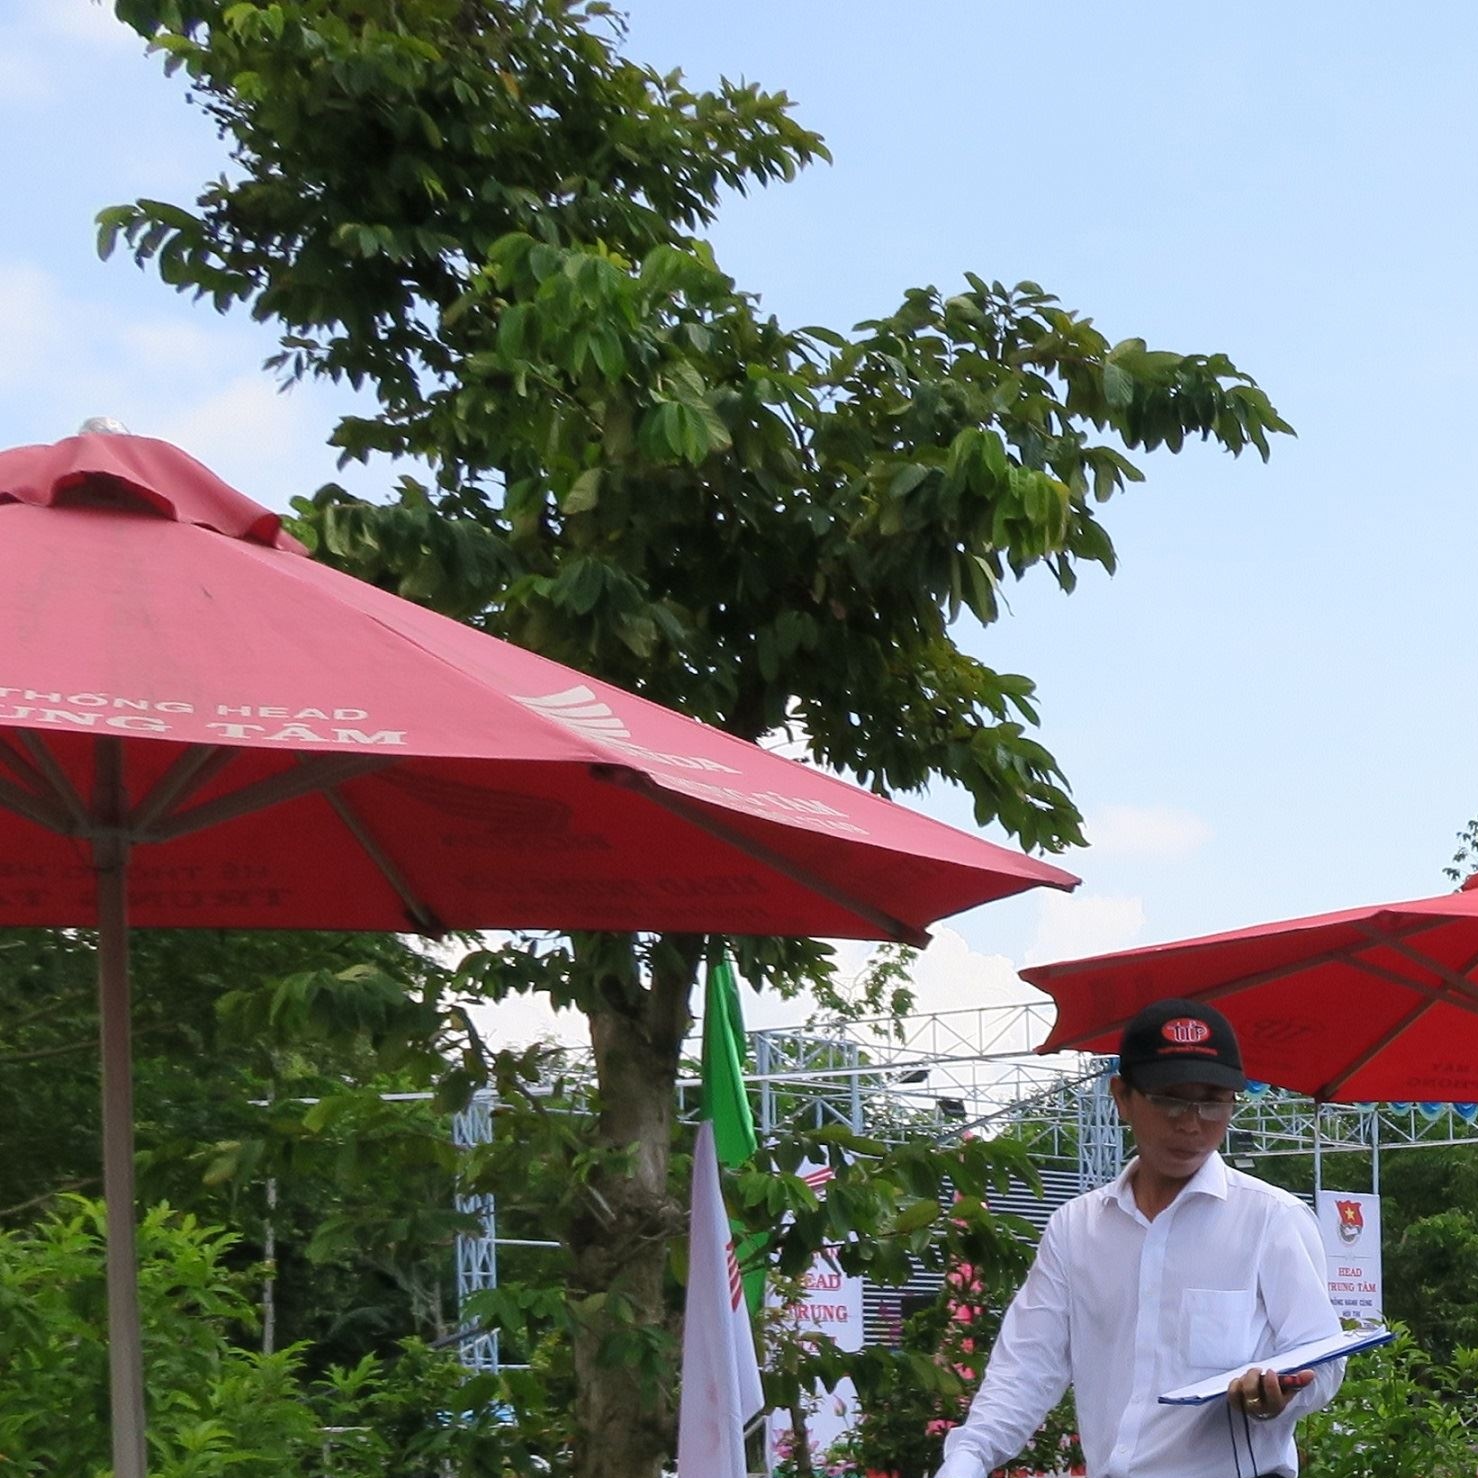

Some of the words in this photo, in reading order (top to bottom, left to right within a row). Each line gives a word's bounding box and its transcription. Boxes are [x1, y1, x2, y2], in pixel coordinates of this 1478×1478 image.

[217, 704, 369, 721] HEAD
[206, 721, 408, 746] TÂM
[1338, 1267, 1362, 1277] HEAD
[1358, 1280, 1376, 1293] TÂM
